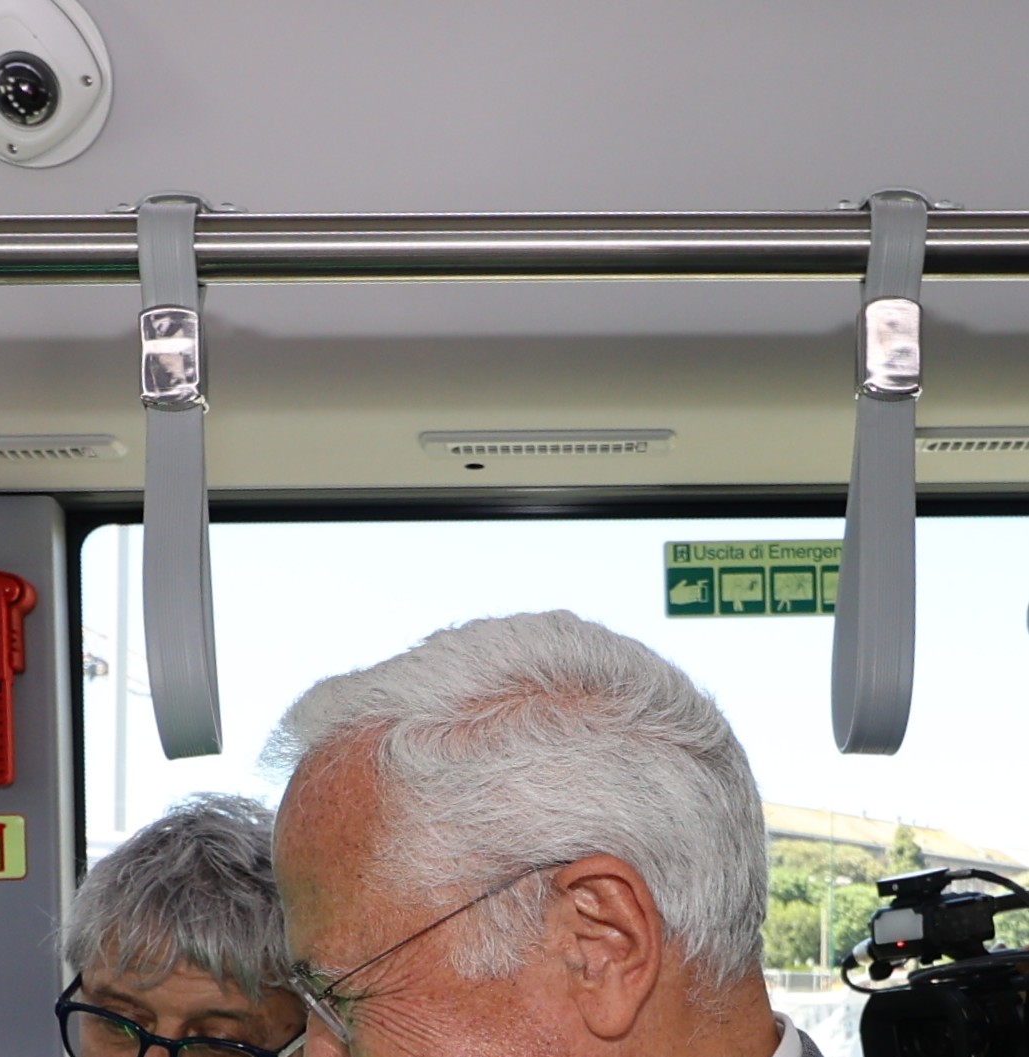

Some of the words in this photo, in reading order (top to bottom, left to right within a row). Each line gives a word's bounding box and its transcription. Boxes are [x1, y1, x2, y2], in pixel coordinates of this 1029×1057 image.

[693, 545, 745, 561] Uscita
[749, 544, 763, 560] di
[768, 544, 843, 563] Emergen
